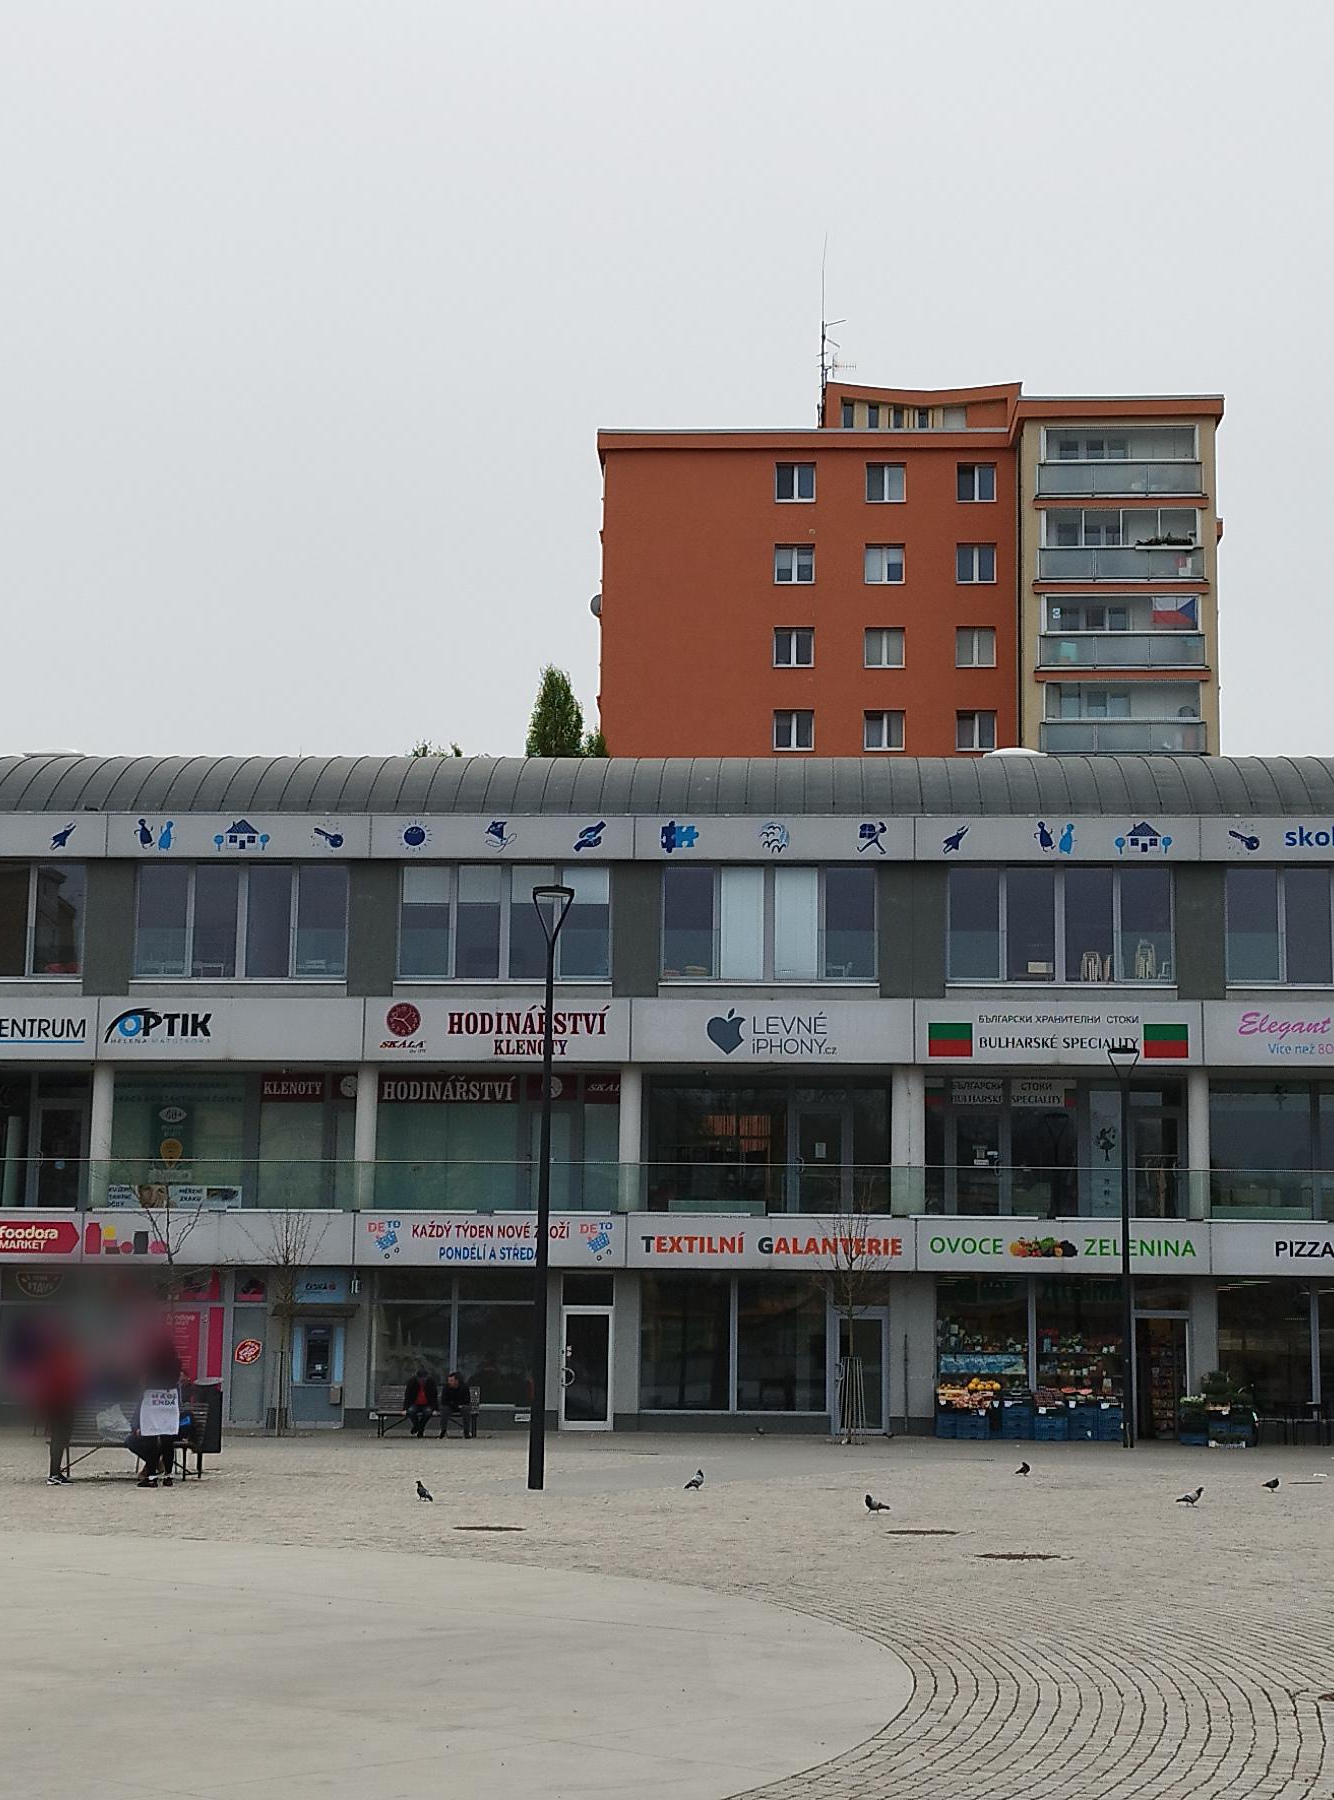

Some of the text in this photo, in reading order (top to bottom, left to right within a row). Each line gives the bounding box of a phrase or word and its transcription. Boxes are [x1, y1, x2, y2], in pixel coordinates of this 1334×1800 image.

[752, 1011, 828, 1035] LEVNÉ
[978, 1015, 1140, 1025] БЪЛГАРСКИ ХРАНИТЕЛНИ СТОКИ
[1237, 1011, 1331, 1041] Elegant
[979, 1034, 1140, 1049] BULHARSKÉ SPECIALITY
[263, 1081, 323, 1096] KLENOTY
[382, 1075, 516, 1101] HODINÁŘSTVÍ
[411, 1220, 570, 1239] KAŽDÝ TÝDEN NOVÉ ZOŽÍ
[489, 1246, 497, 1260] A
[641, 1232, 903, 1257] TEXTILNÍ GALANTERIE
[929, 1236, 1004, 1256] OVOCE
[1275, 1239, 1334, 1259] PIZZA
